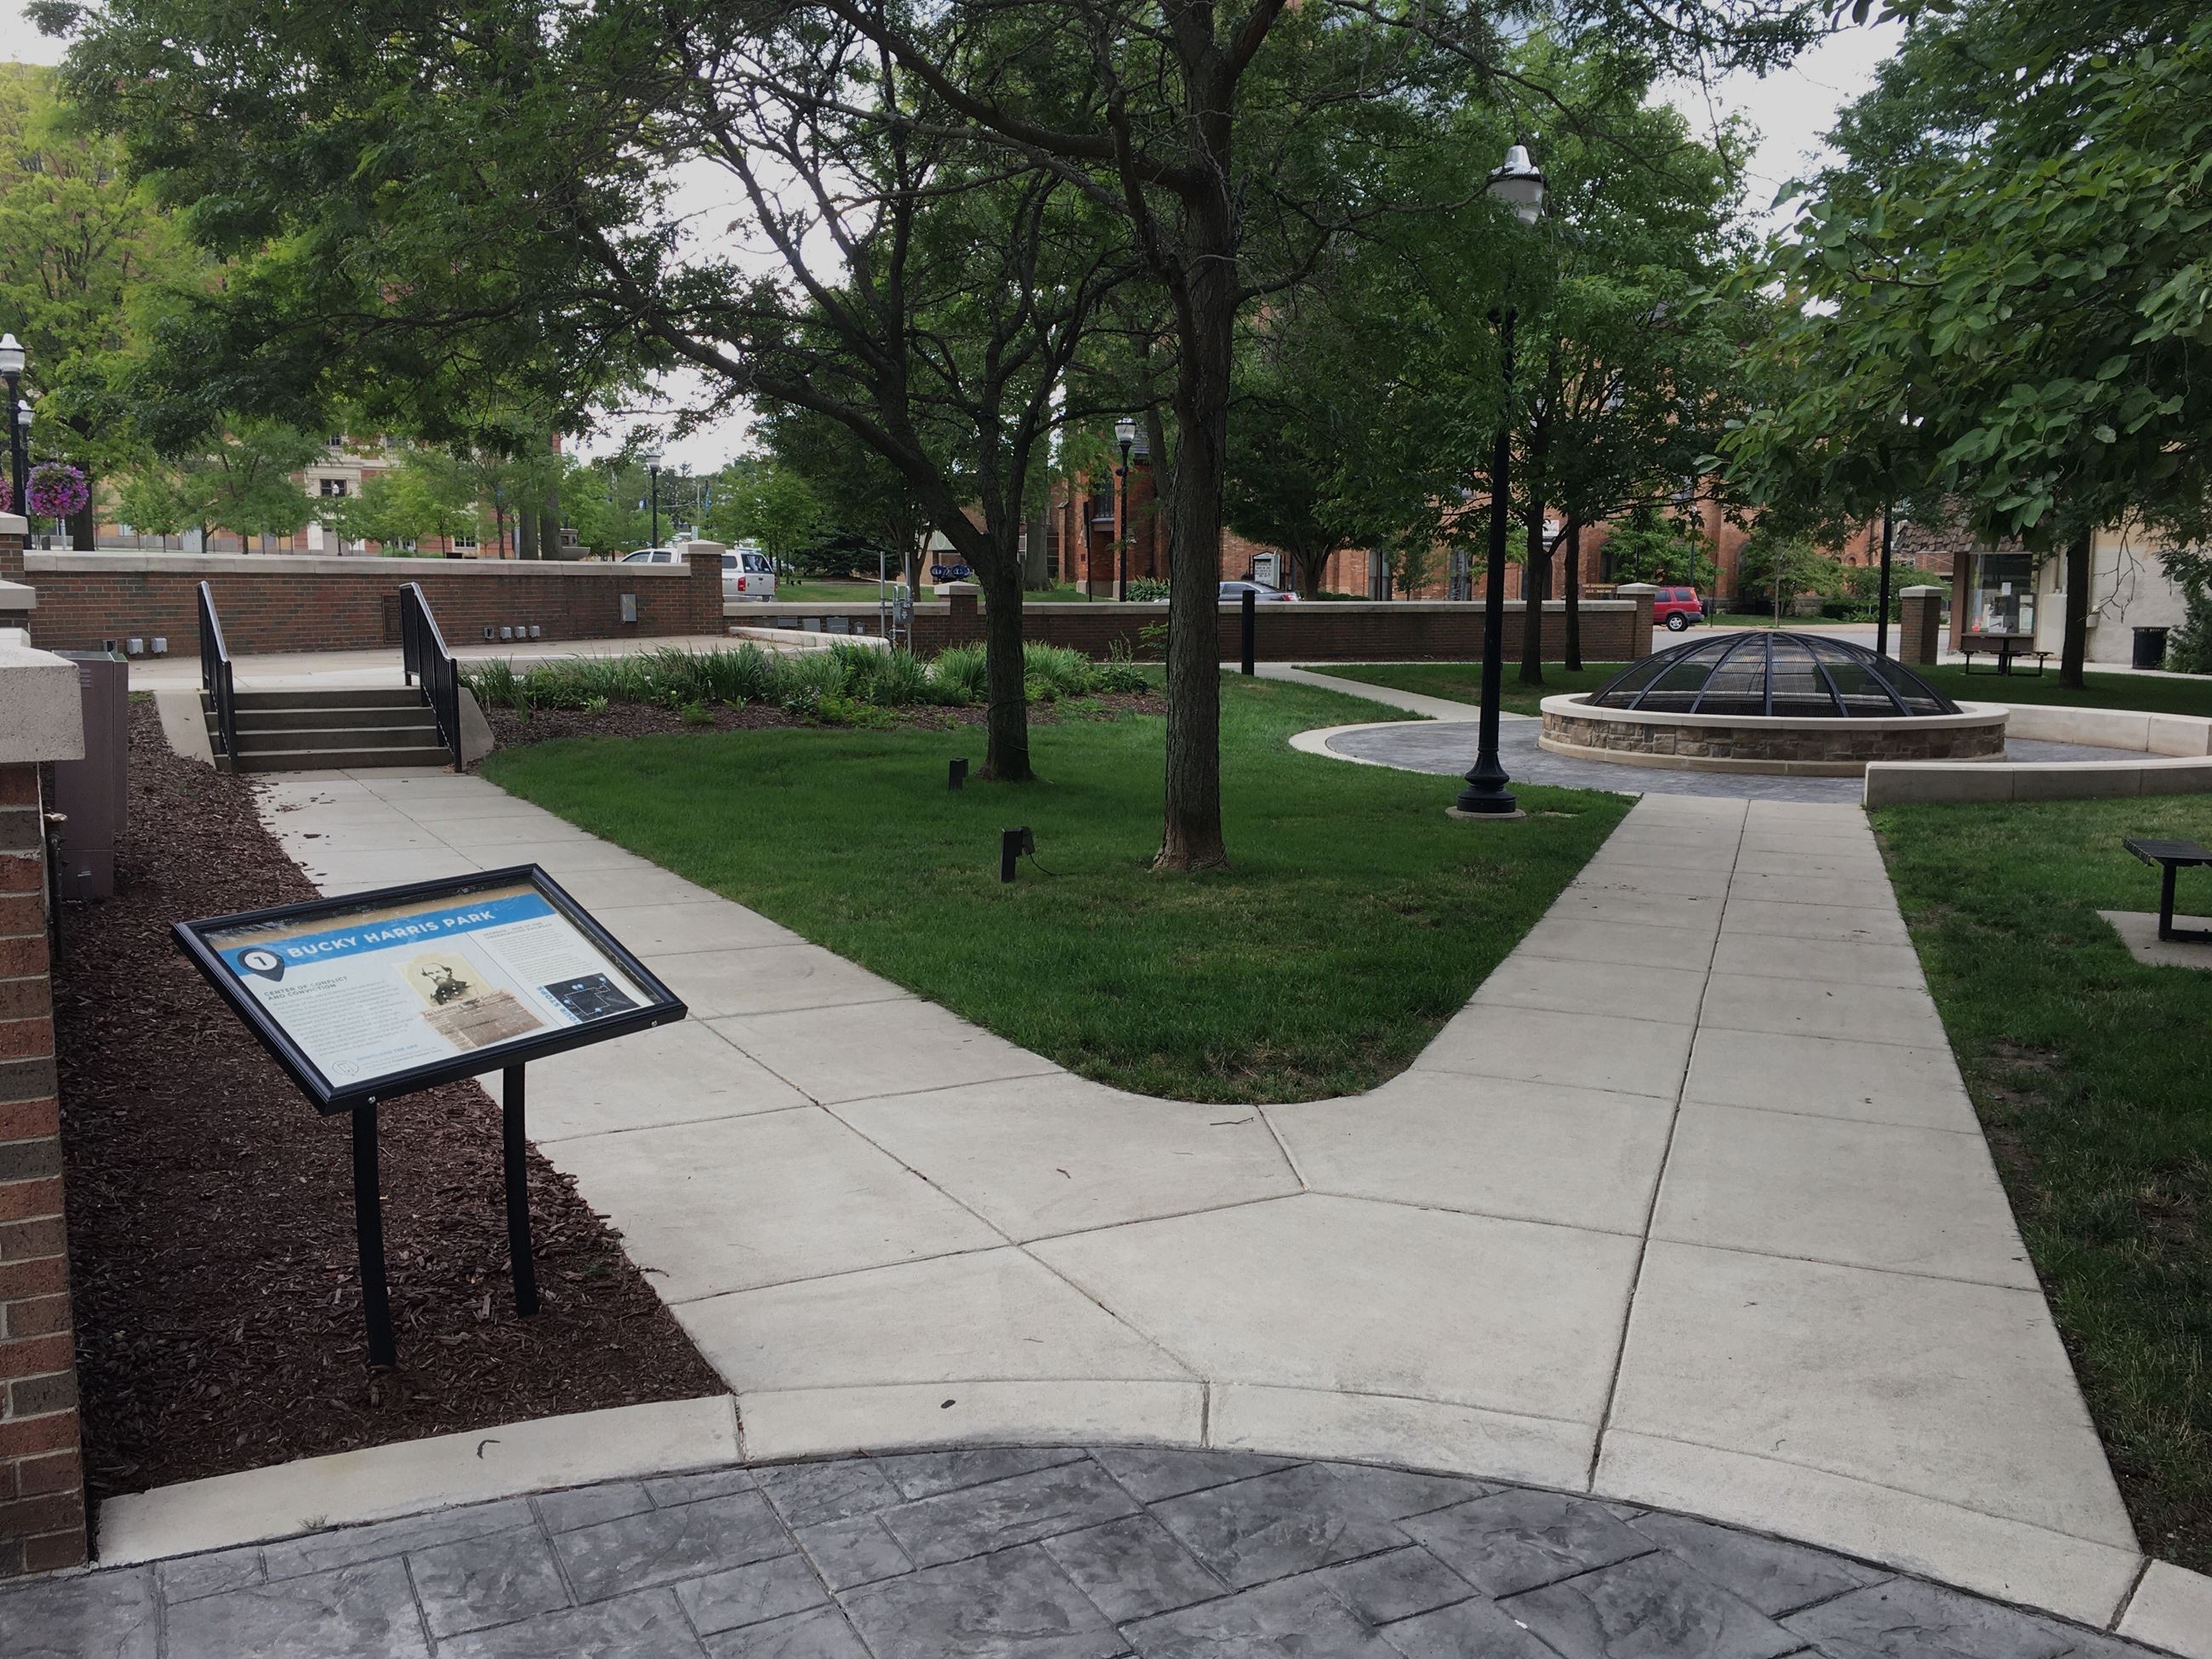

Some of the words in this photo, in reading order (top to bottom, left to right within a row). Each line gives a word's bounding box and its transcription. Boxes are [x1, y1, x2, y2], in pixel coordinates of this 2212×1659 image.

[286, 937, 358, 958] BUCKY
[363, 921, 439, 944] HARRIS
[442, 910, 496, 927] PARK
[254, 955, 267, 966] 1
[264, 987, 295, 997] CENTER
[310, 976, 348, 987] CONFLICT
[288, 983, 337, 997] CONVICTION
